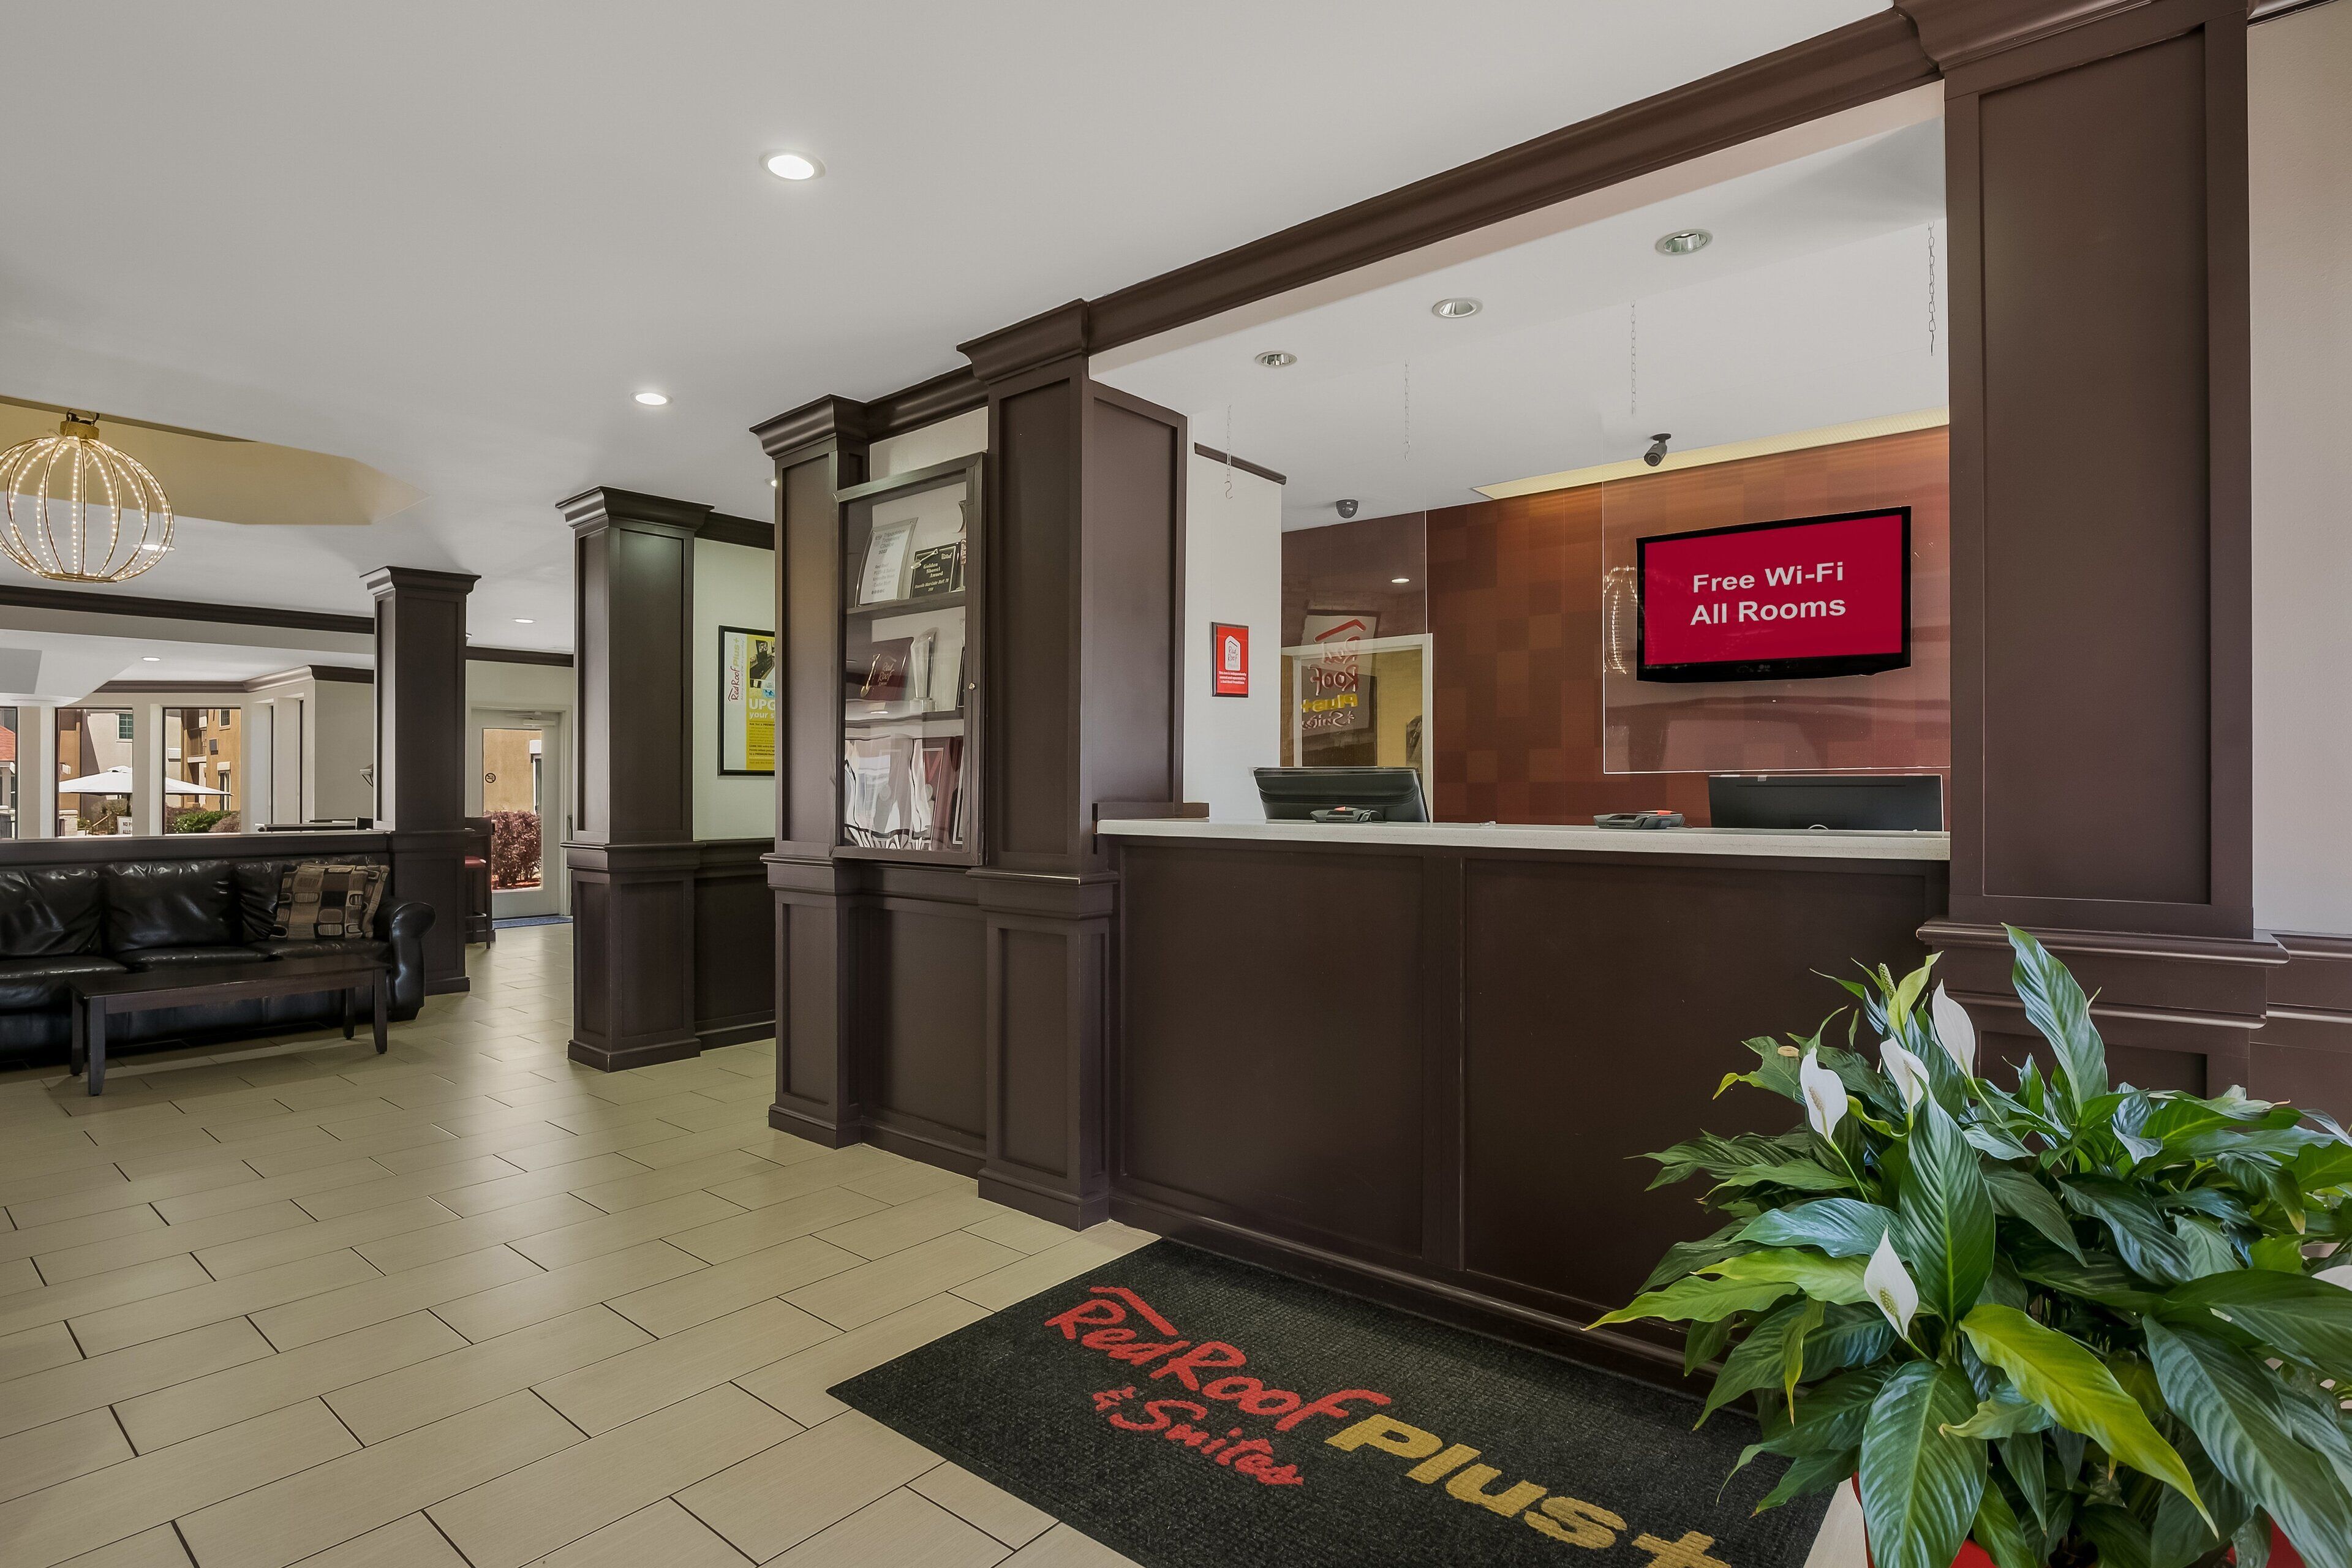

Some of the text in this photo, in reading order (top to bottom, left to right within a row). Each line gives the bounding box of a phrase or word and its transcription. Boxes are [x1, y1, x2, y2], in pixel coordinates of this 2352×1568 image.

[1694, 562, 1843, 593] Free Wi-Fi
[1690, 599, 1846, 626] All Rooms
